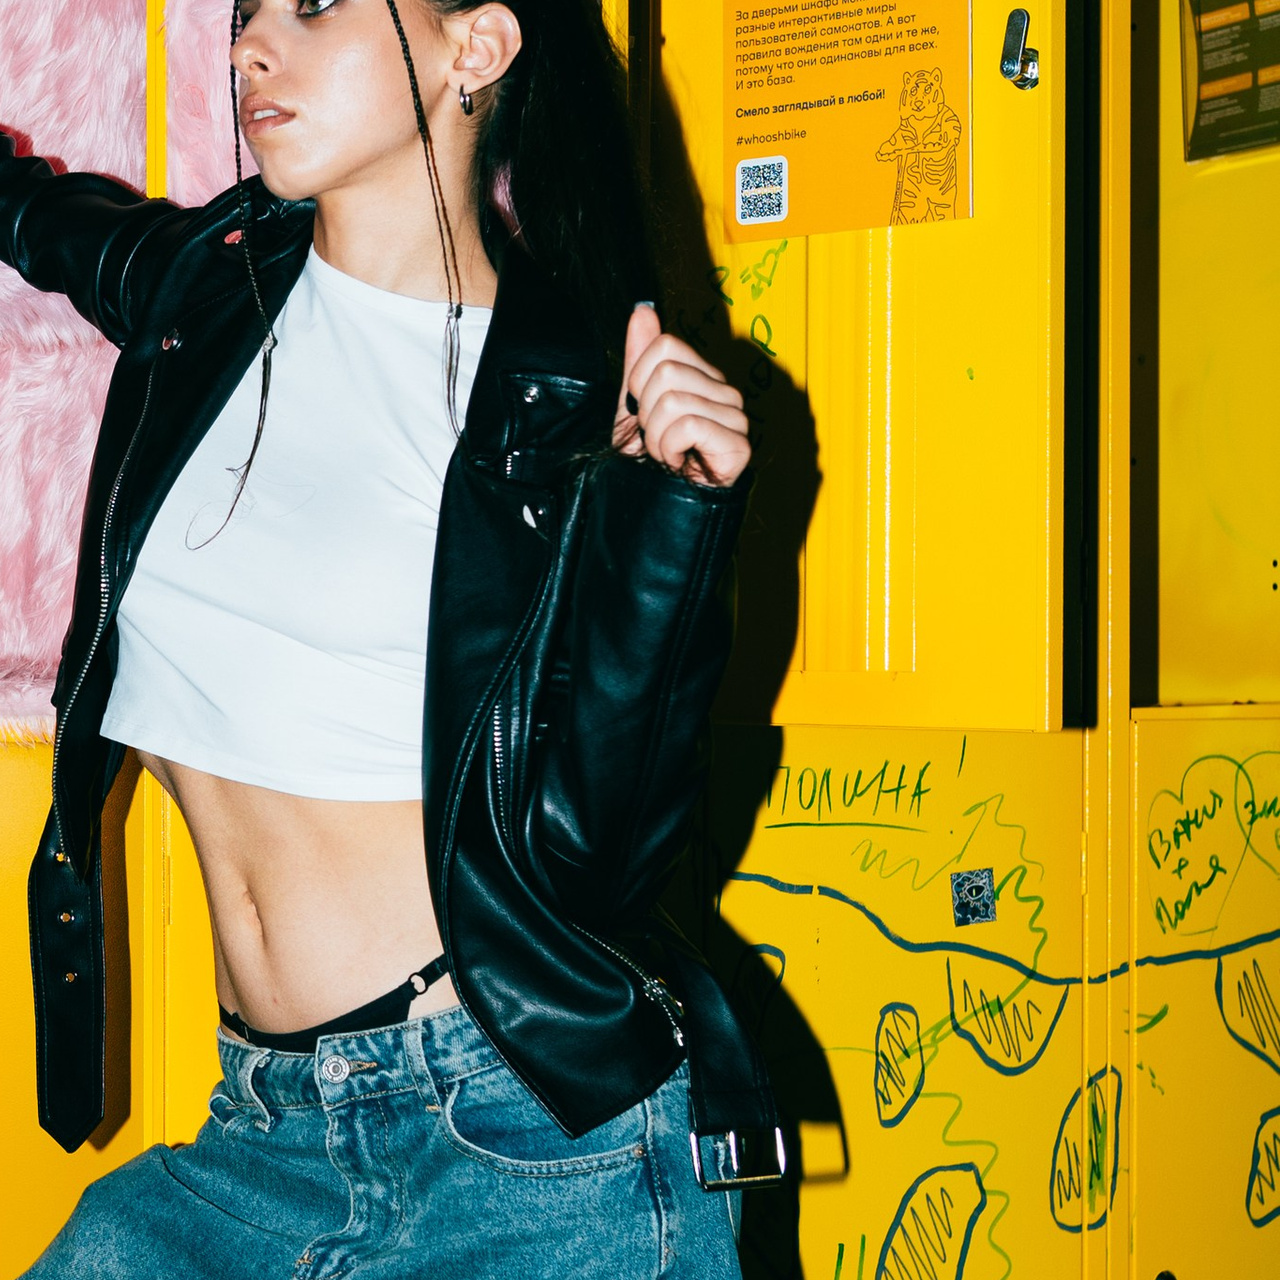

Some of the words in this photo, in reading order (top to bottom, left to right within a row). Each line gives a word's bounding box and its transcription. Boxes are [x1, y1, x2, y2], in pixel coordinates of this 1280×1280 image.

[736, 10, 750, 22] За
[751, 4, 799, 21] дверьми
[736, 22, 776, 38] разные
[778, 8, 864, 29] интерактивные
[866, 3, 897, 16] миры
[736, 26, 818, 50] пользователей
[886, 16, 895, 27] А
[898, 14, 917, 25] вот
[736, 49, 783, 66] правила
[785, 40, 840, 57] вождения
[842, 37, 863, 48] там
[865, 32, 893, 45] одни
[896, 31, 904, 40] и
[906, 29, 919, 39] те
[736, 64, 775, 78] потому
[776, 61, 795, 72] что
[797, 58, 818, 69] они
[820, 49, 883, 66] одинаковы
[884, 45, 906, 58] для
[736, 80, 744, 91] И
[746, 79, 765, 90] это
[736, 107, 771, 119] Смело
[772, 95, 837, 115] заглядывай
[839, 97, 845, 106] в
[736, 129, 807, 147] #whooshbike
